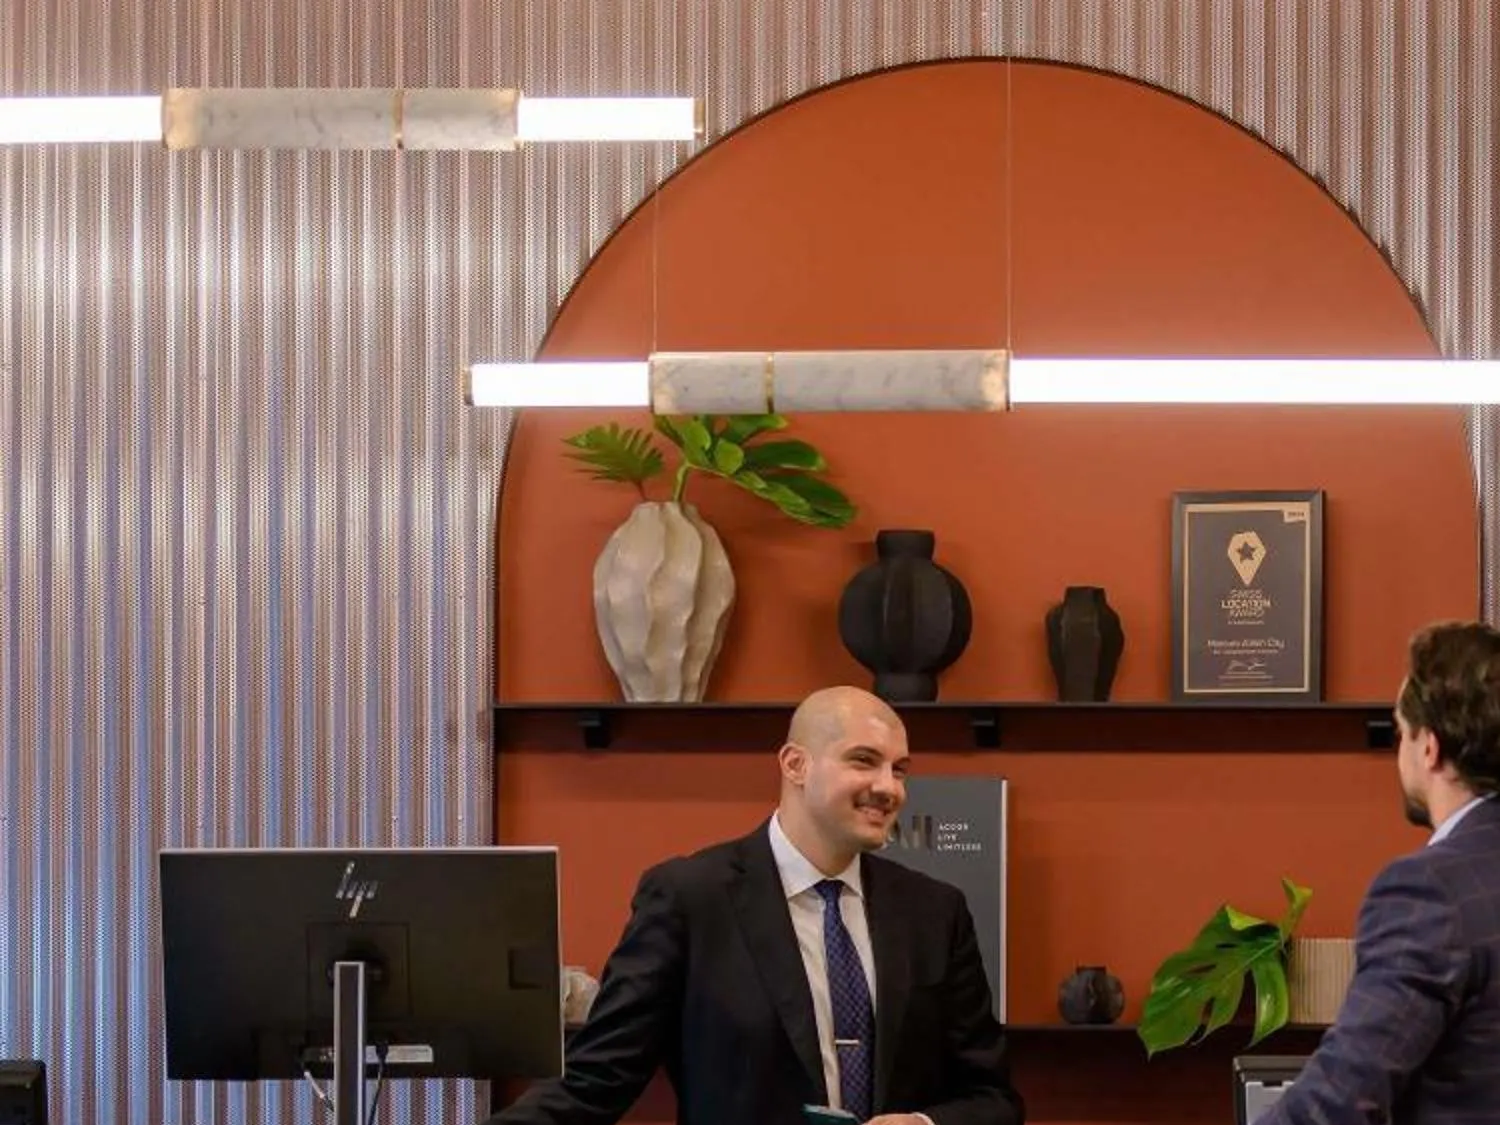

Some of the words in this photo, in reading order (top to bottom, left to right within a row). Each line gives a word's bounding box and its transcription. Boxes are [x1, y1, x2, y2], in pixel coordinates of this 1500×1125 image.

[1221, 599, 1271, 609] LOCATION
[938, 823, 969, 831] ACCOR
[335, 861, 379, 918] hp
